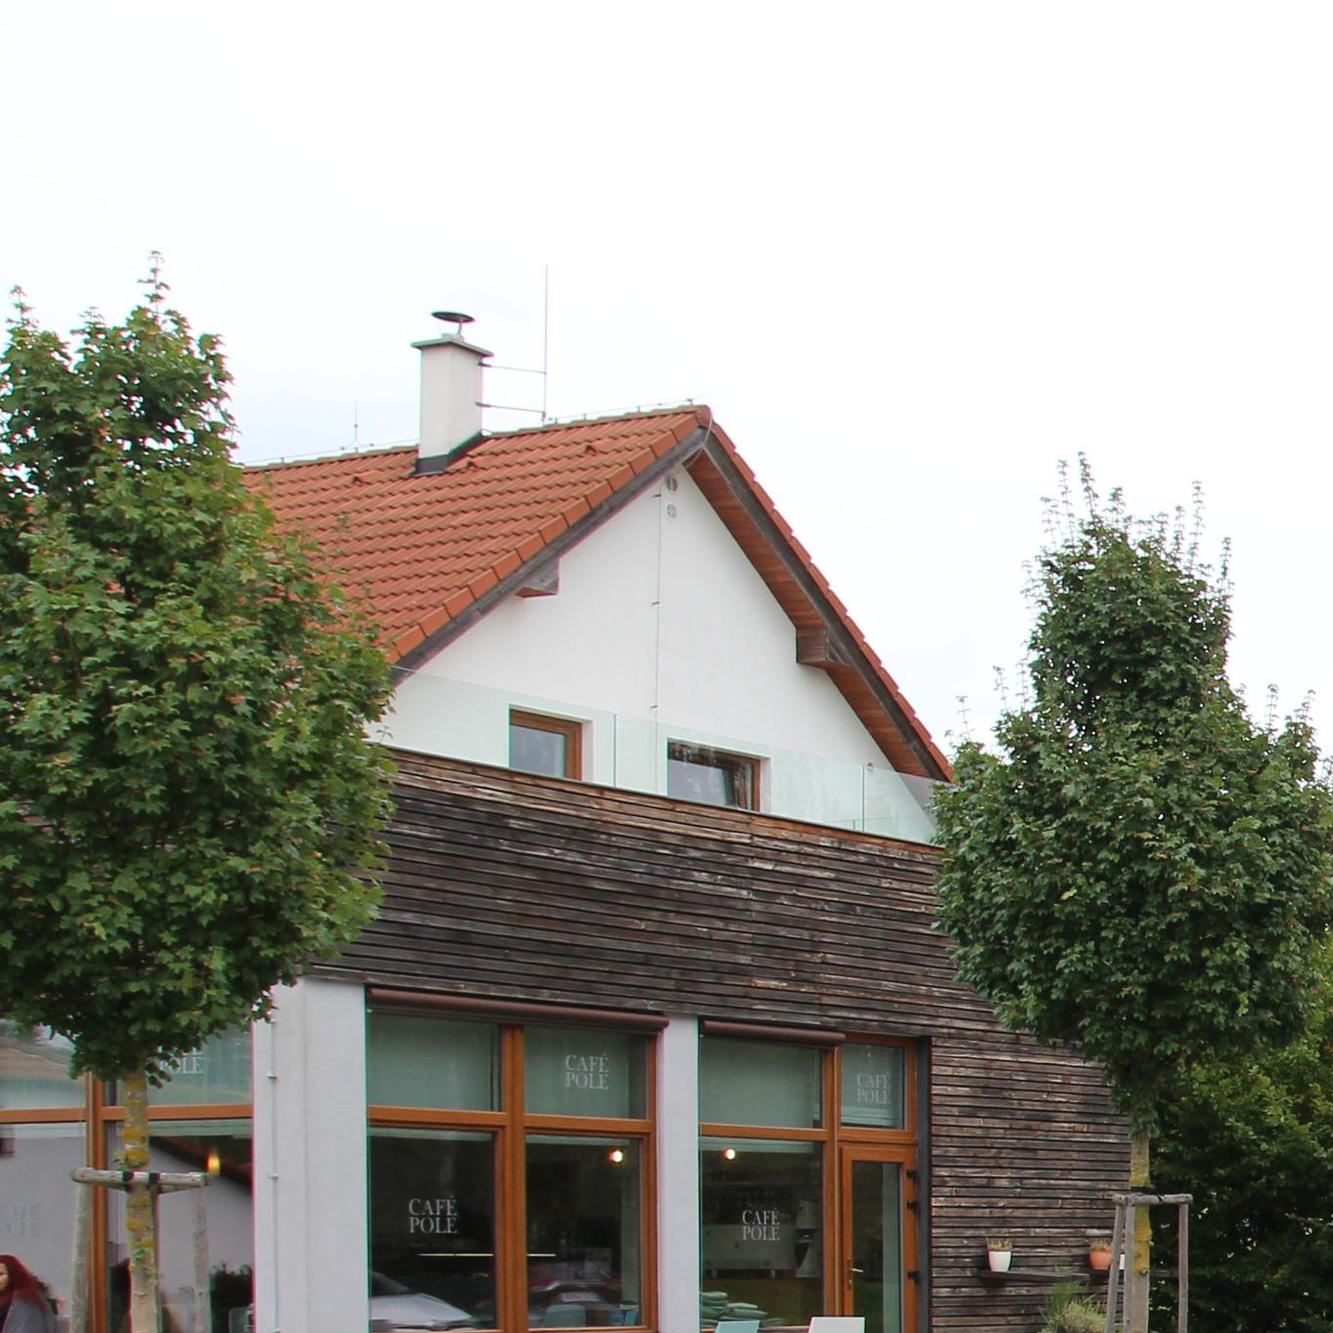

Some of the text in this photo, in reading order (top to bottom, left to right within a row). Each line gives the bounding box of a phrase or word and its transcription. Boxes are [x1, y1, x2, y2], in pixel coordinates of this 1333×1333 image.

[565, 1053, 609, 1072] CAFÉ
[565, 1072, 609, 1090] POLE
[858, 1088, 891, 1104] POLE
[409, 1195, 458, 1216] CAFÉ
[410, 1216, 458, 1234] POLE
[742, 1207, 780, 1225] CAFÉ
[743, 1225, 780, 1241] POLE
